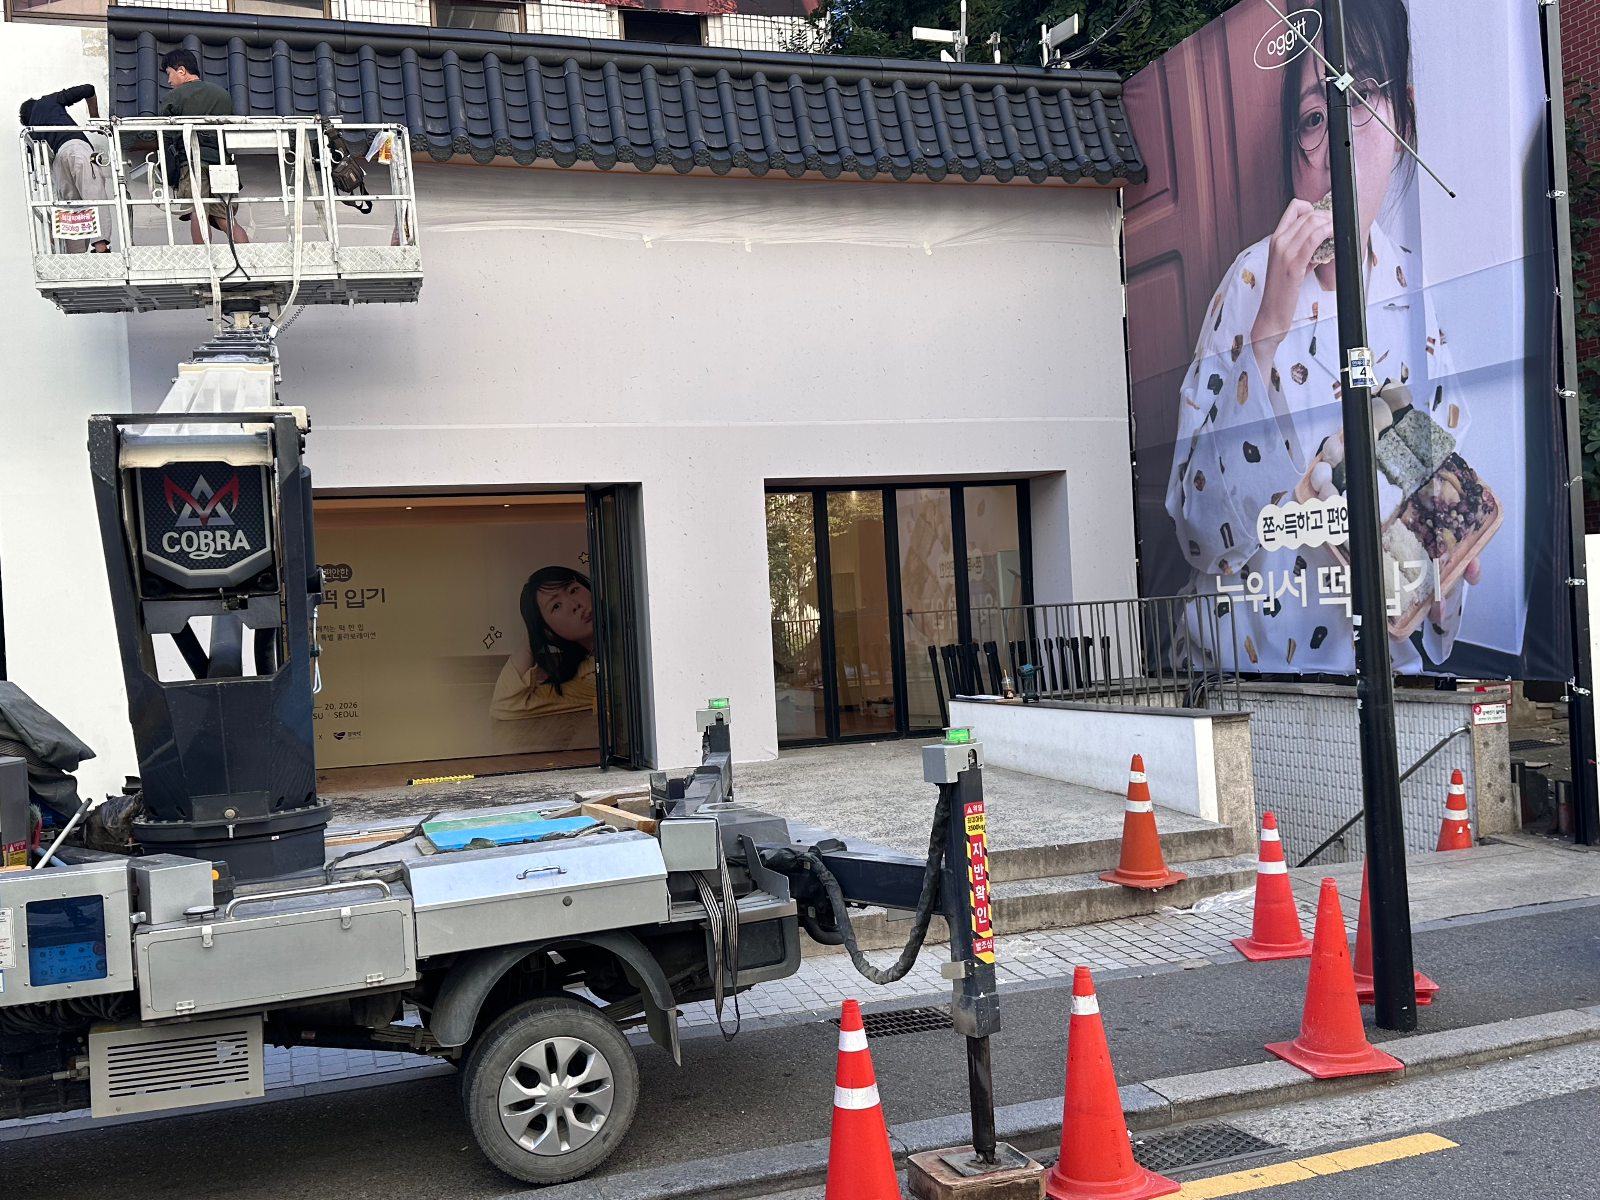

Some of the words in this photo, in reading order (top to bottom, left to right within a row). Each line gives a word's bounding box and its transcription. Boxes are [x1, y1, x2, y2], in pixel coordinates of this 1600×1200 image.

[1262, 509, 1323, 542] 쫀~득하고
[162, 530, 251, 560] COBRA
[344, 588, 386, 609] 입기
[1216, 568, 1307, 613] 누워서
[313, 712, 324, 720] SU
[333, 710, 359, 719] SEOUL
[339, 701, 358, 710] 2026
[972, 841, 988, 925] 지반확인
